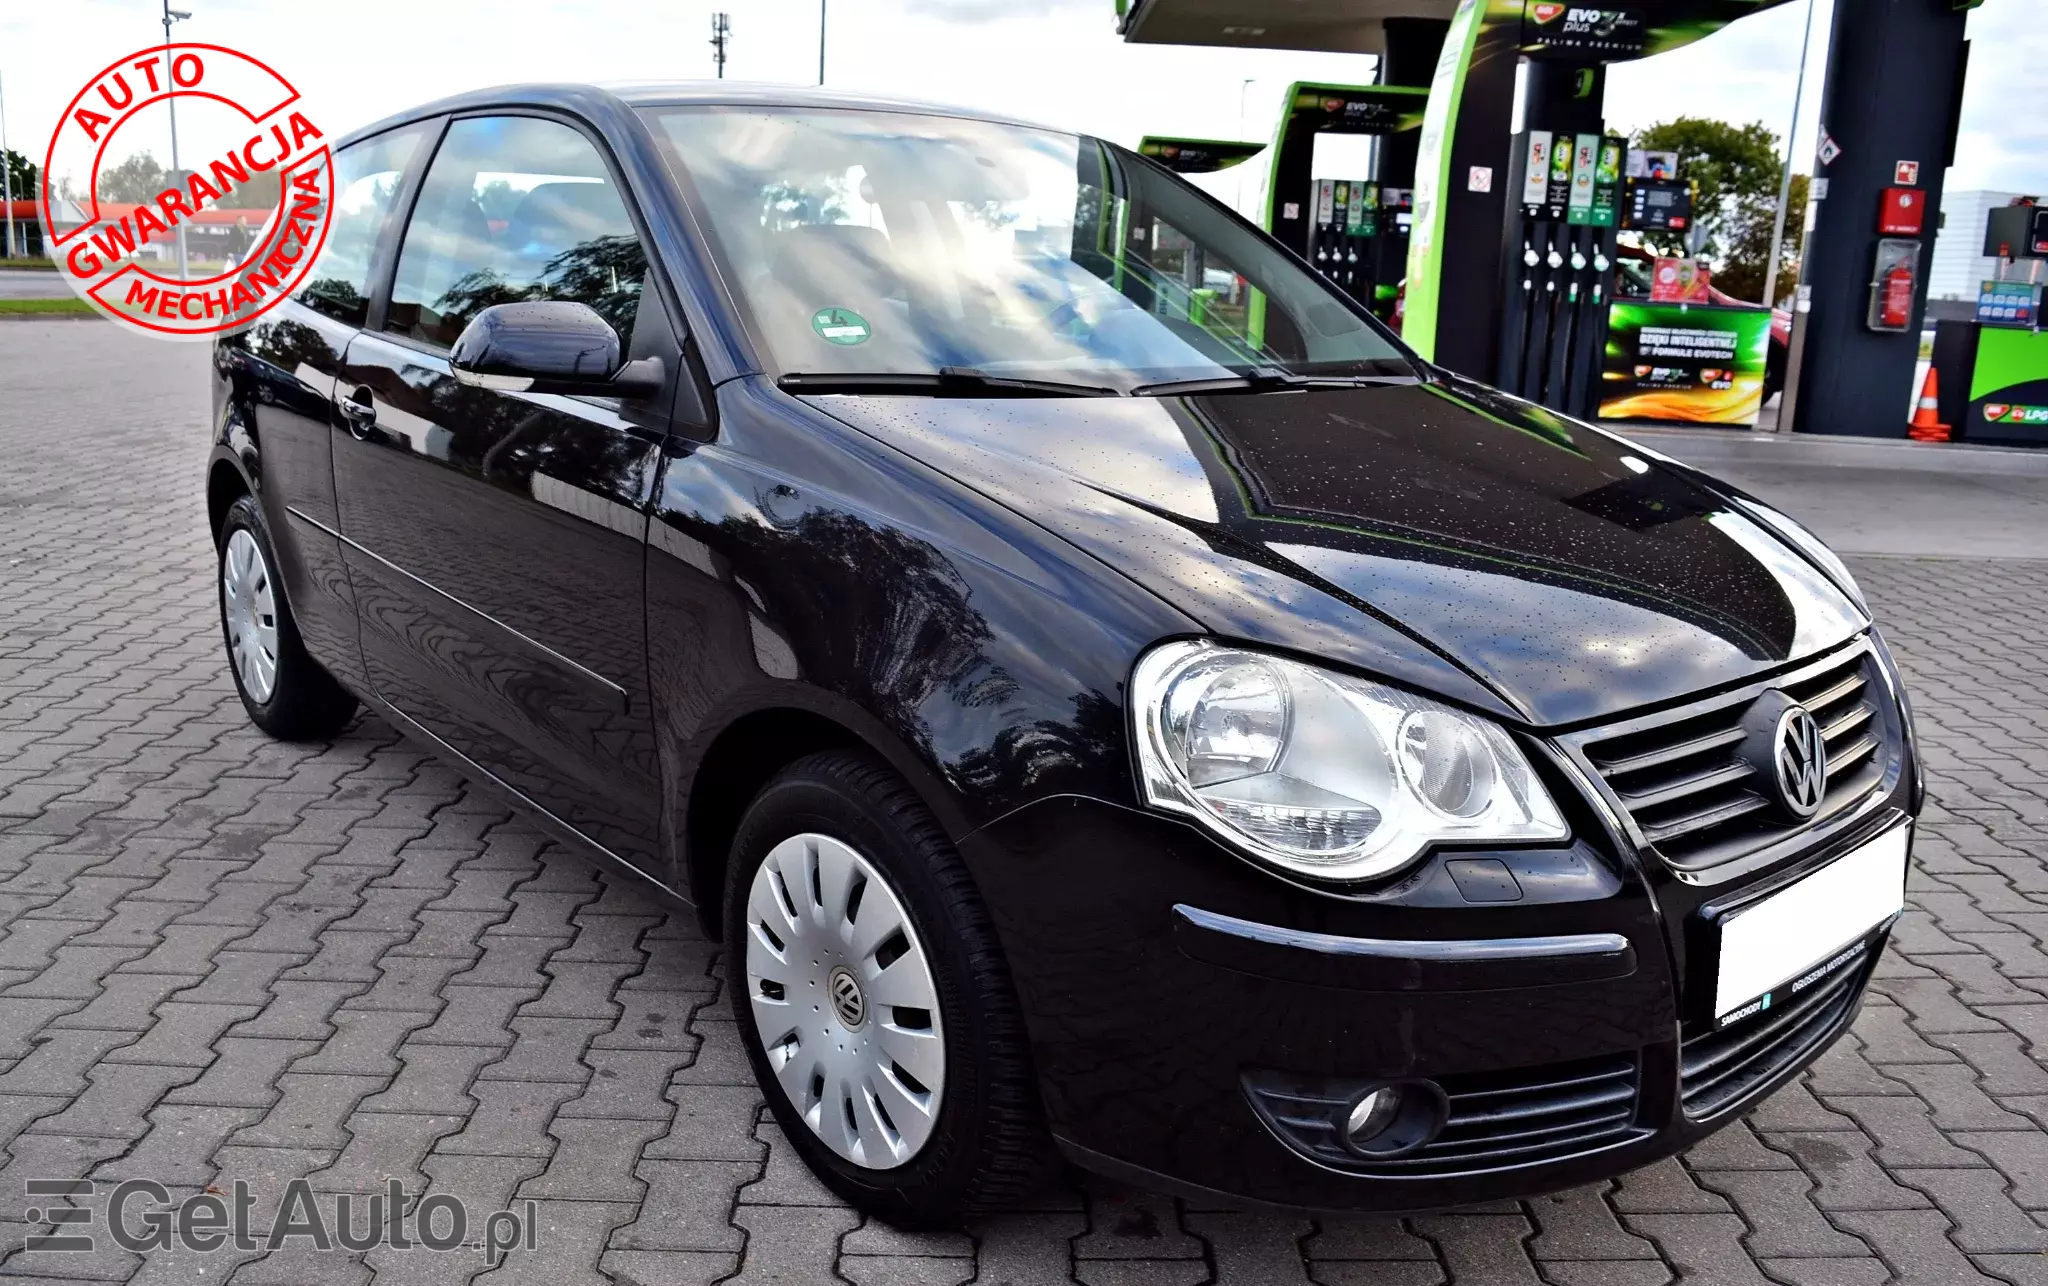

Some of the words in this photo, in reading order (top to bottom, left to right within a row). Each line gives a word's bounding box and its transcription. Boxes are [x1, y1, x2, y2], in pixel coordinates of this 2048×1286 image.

[1567, 8, 1601, 23] EVO
[1562, 21, 1590, 33] plus
[1721, 1000, 1762, 1027] SAMOCHODY
